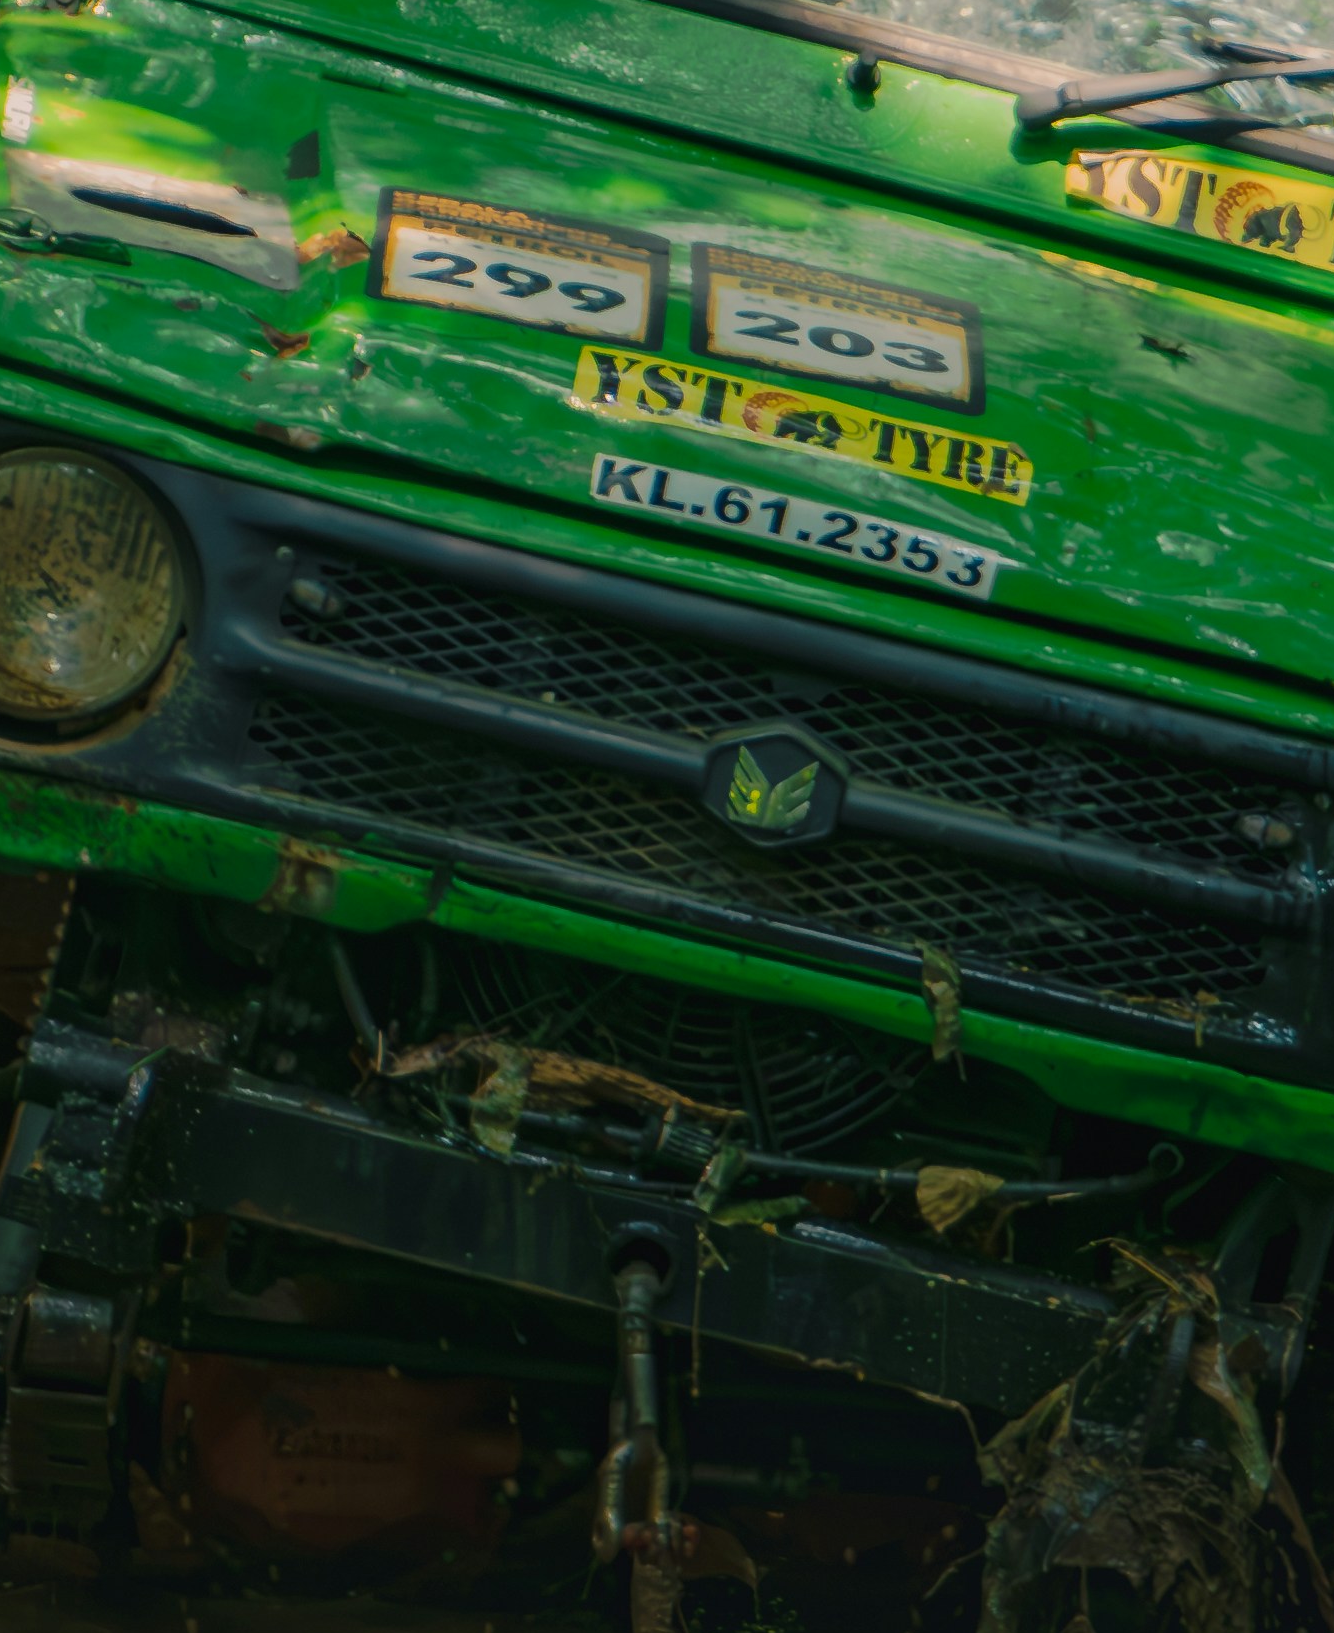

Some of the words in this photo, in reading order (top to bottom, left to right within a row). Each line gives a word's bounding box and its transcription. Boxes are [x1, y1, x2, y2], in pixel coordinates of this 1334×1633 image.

[409, 251, 627, 314] 299
[734, 310, 950, 374] 203
[589, 350, 744, 425] YST
[869, 417, 1030, 496] TYRE
[595, 458, 986, 588] KL.61.2353
